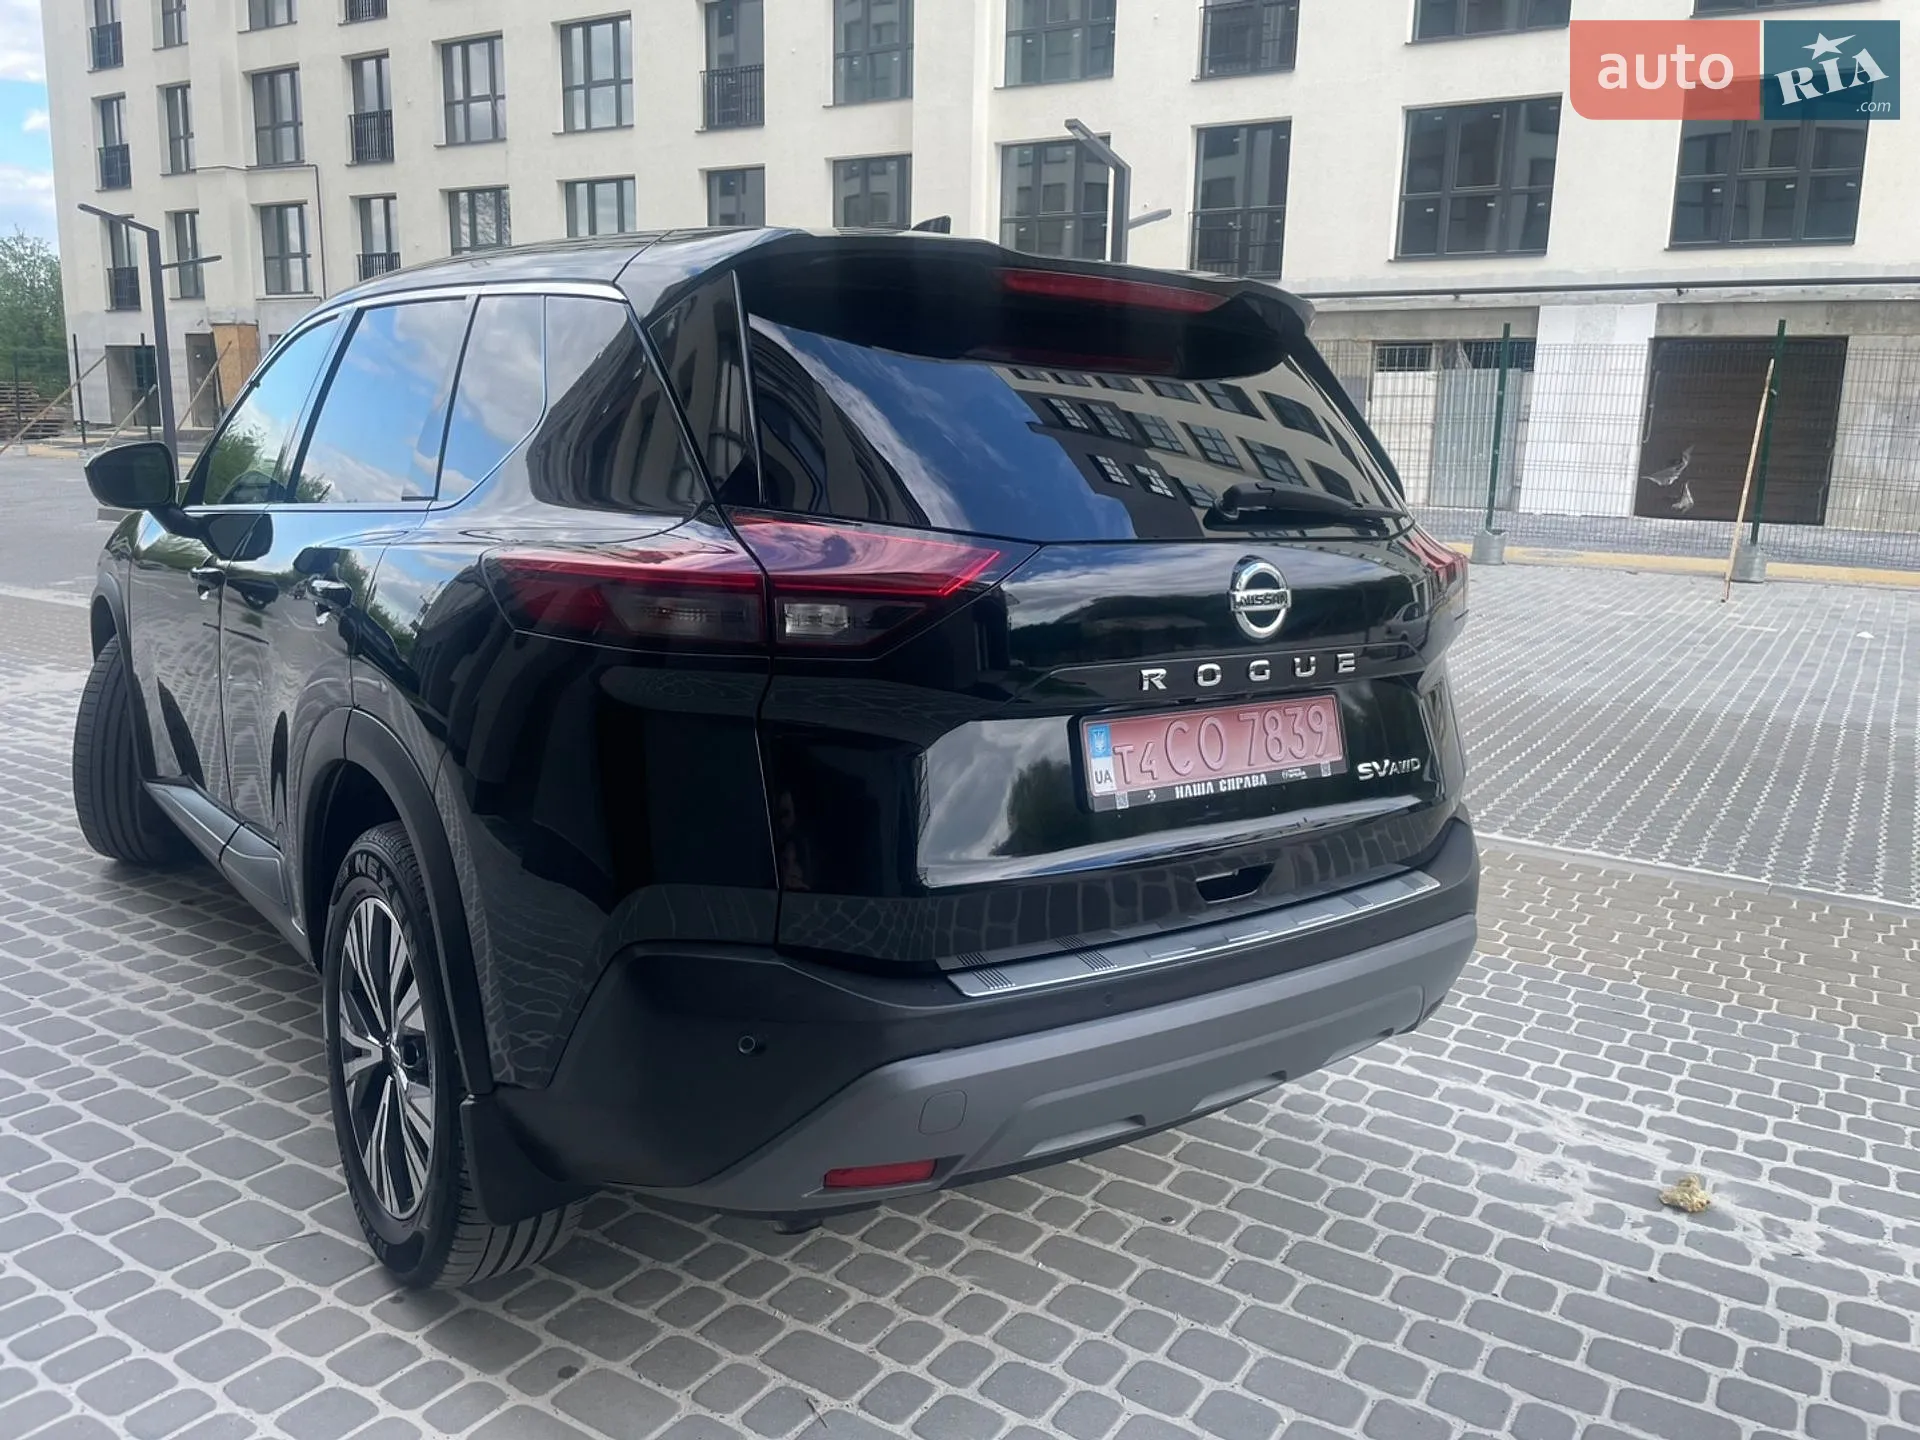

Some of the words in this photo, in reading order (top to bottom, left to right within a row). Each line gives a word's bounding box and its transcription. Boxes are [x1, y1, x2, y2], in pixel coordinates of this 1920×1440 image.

[1233, 590, 1288, 608] NISSAN
[1140, 653, 1355, 691] ROGUE
[1237, 704, 1329, 767] 7839
[1094, 769, 1112, 785] UA
[1175, 781, 1215, 800] НАША
[1219, 773, 1268, 794] СПРАВА
